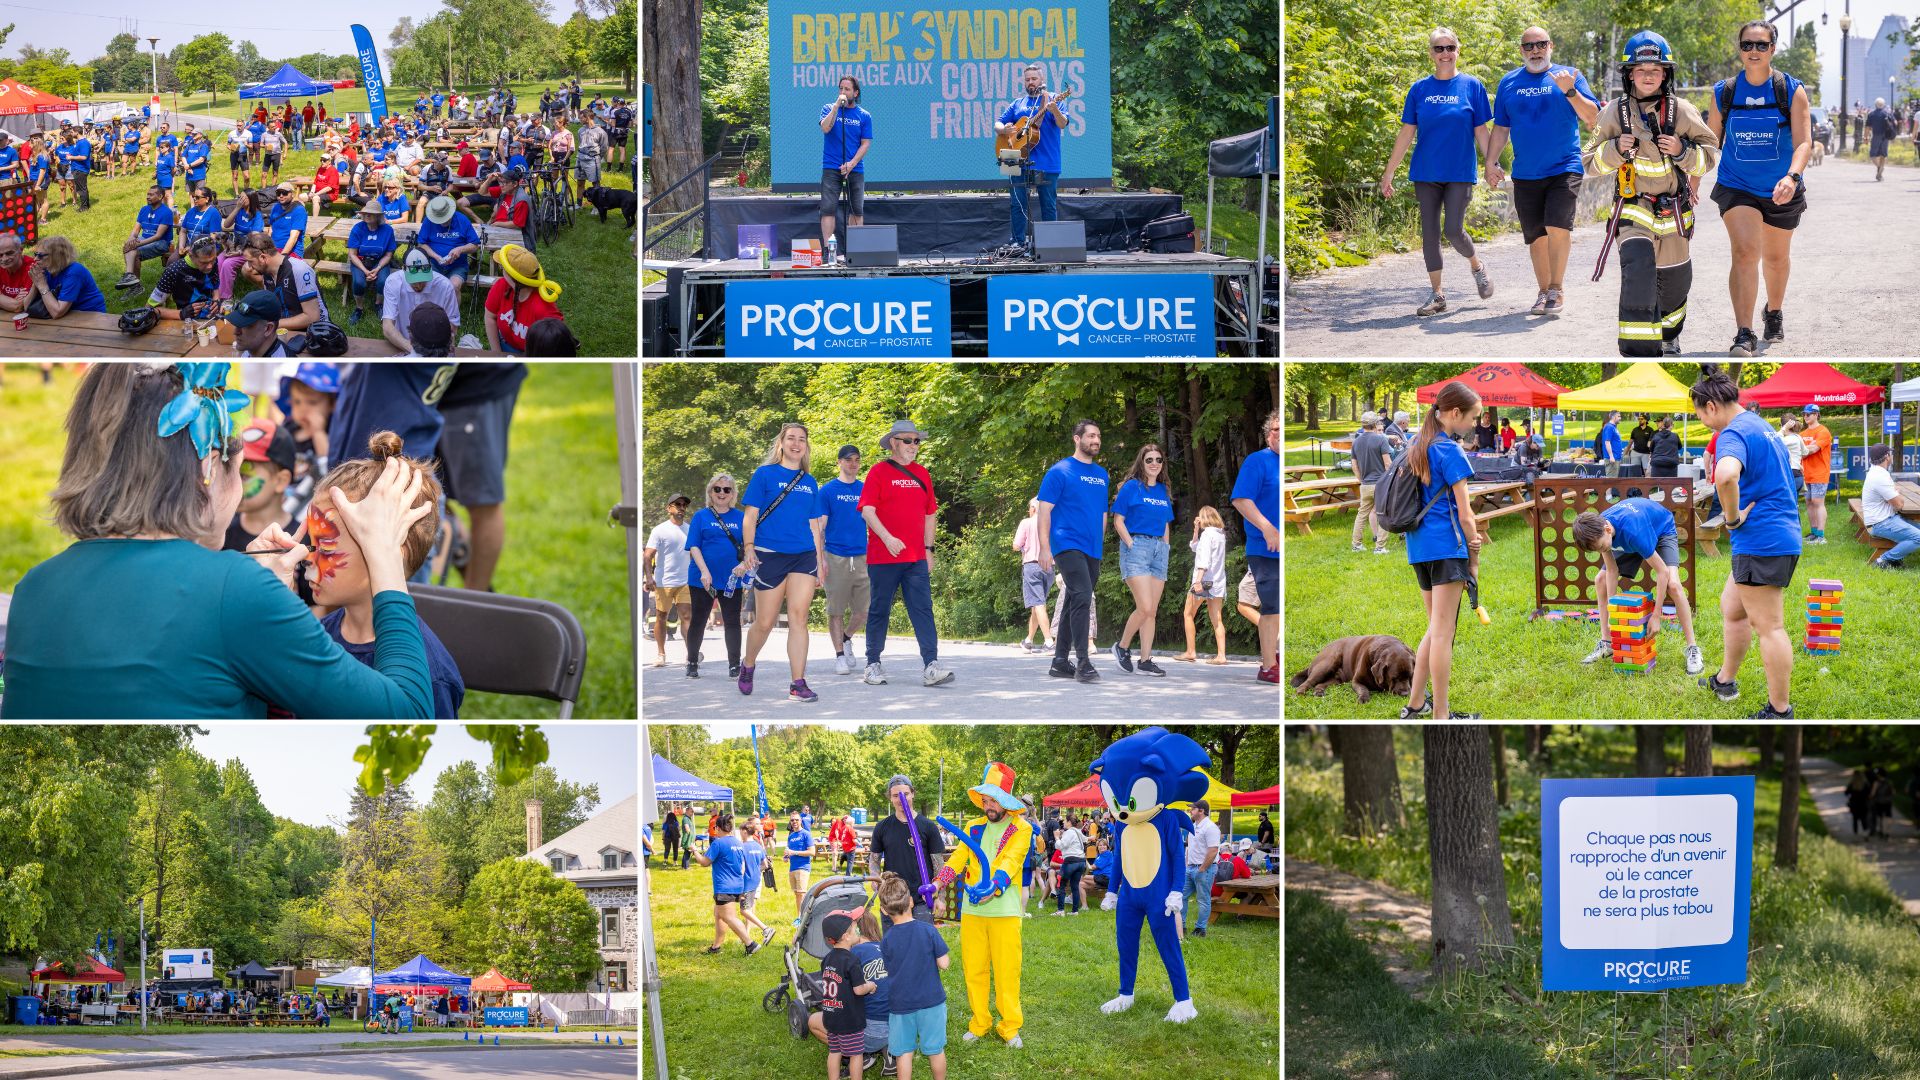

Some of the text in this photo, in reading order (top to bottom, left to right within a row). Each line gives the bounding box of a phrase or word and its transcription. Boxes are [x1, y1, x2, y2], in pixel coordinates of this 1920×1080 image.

[793, 7, 1085, 64] BREAK SYNDICAL
[360, 48, 380, 103] PROCURE
[793, 62, 933, 88] HOMMAGE AUX
[1516, 85, 1553, 95] PROCURE
[1425, 94, 1459, 103] PROCURE
[930, 100, 1086, 139] FRINS
[1735, 131, 1774, 139] PROCURE
[741, 299, 933, 337] PROCURE
[1004, 295, 1197, 332] PROCURE
[823, 337, 933, 348] CANCER PROSTATE
[1088, 333, 1197, 344] CANCER PROSTATE
[1470, 365, 1513, 377] SCORES
[1492, 393, 1517, 402] levées
[1814, 393, 1846, 402] Montréal
[778, 482, 812, 492] PRCURE
[1586, 831, 1712, 848] Chaque pas nous
[1570, 847, 1727, 867] rapproche d'un avenir
[1605, 867, 1693, 881] où le cancer
[1598, 885, 1699, 902] de la prostate
[1583, 901, 1713, 920] ne sera plus tabou
[1604, 959, 1691, 978] PROCURE
[487, 1010, 525, 1018] PROCURE
